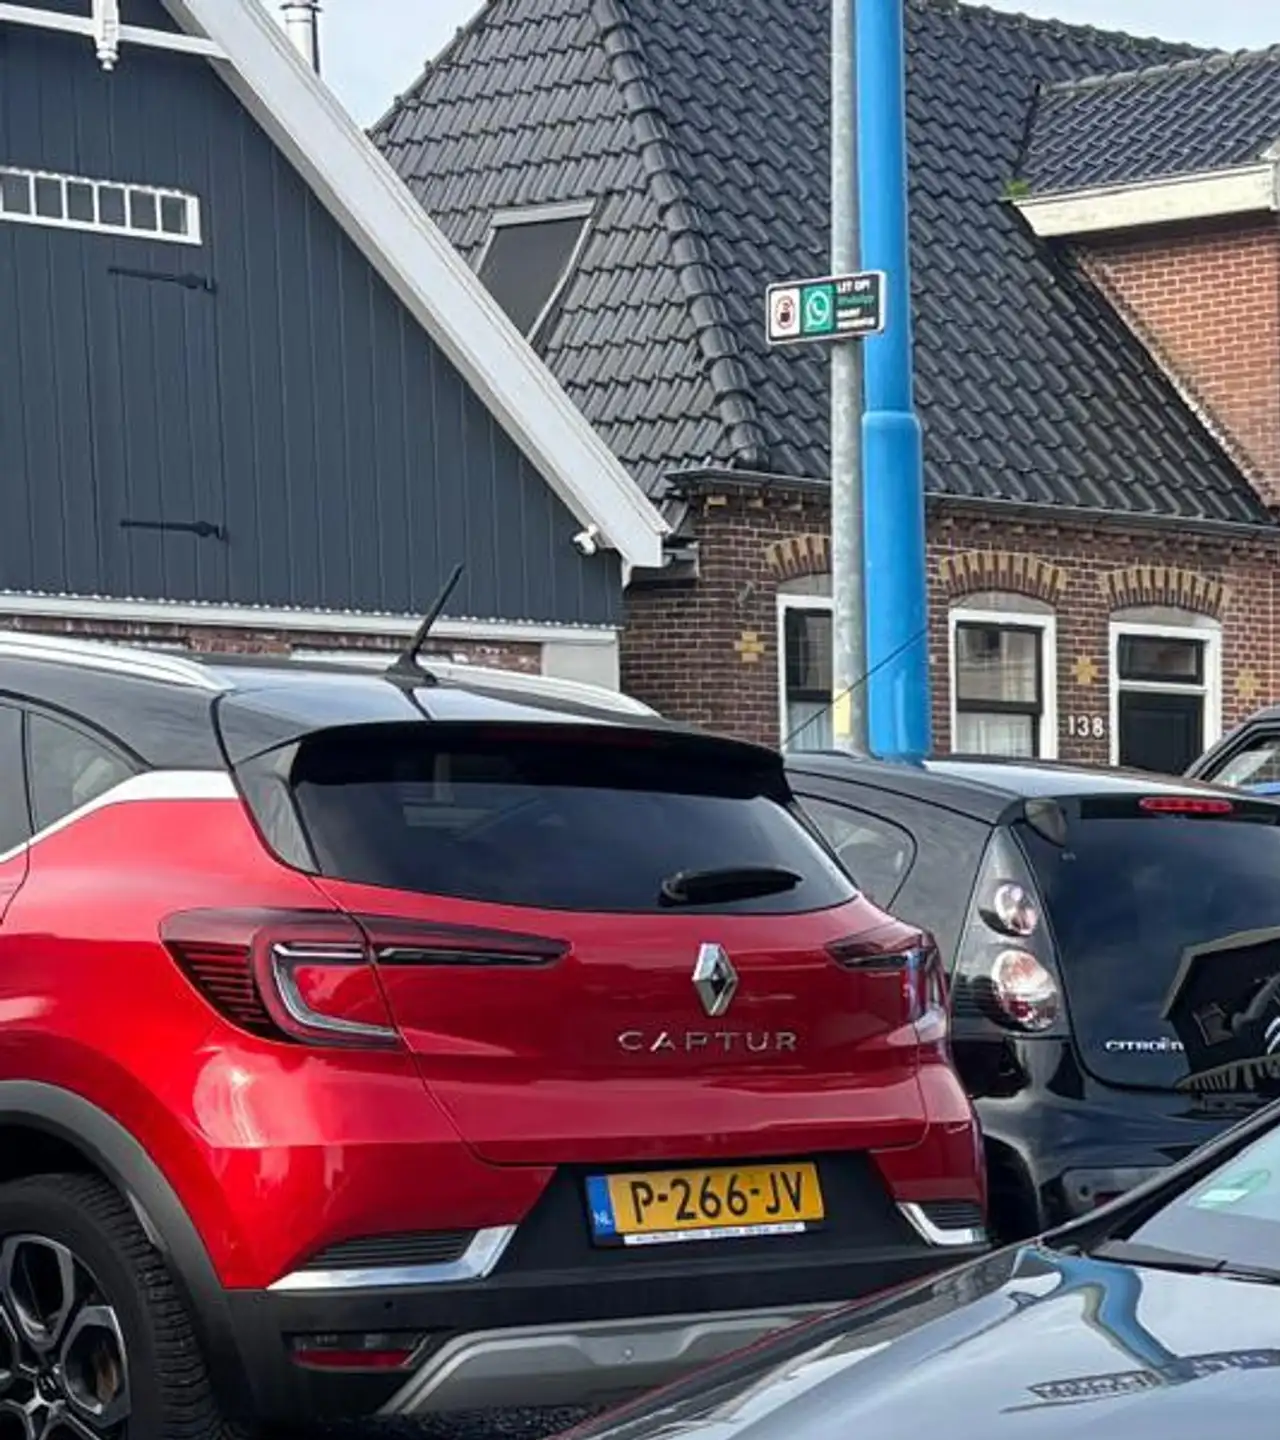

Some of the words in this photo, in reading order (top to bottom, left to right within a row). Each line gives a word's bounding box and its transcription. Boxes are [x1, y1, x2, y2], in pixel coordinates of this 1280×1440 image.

[1067, 715, 1105, 739] 138
[616, 1030, 798, 1053] CAPTUR
[629, 1171, 802, 1225] P-266-JV
